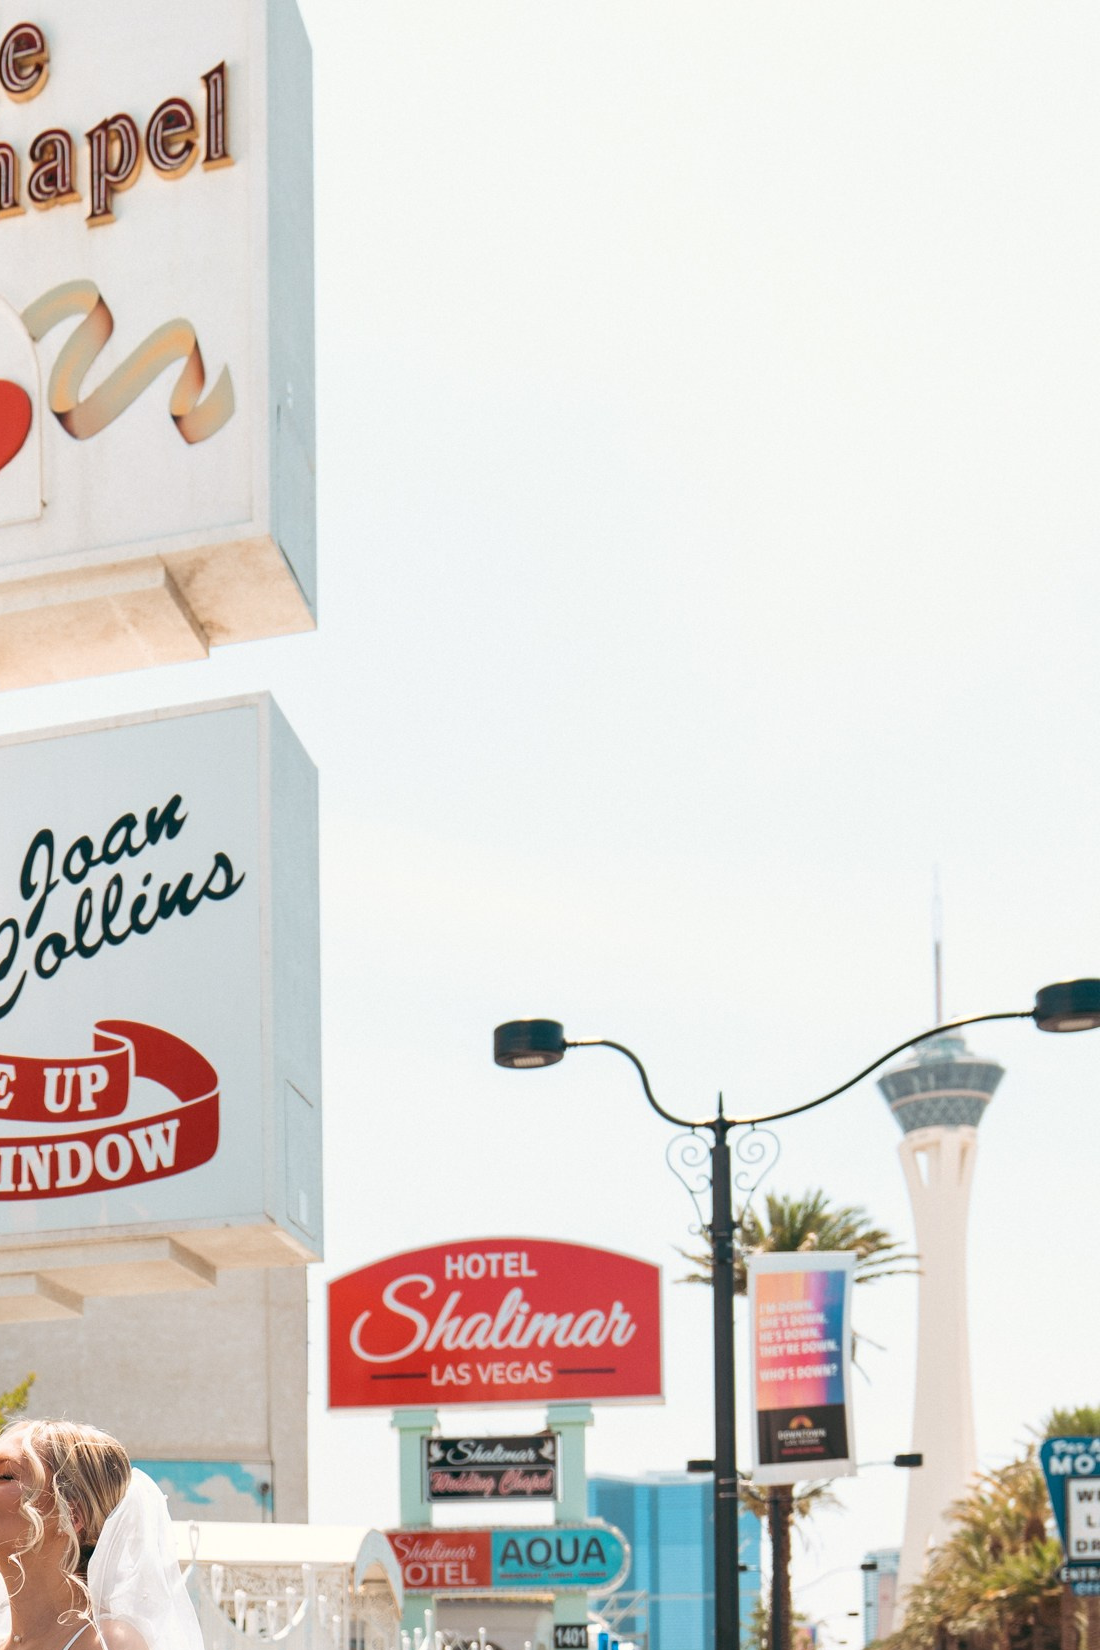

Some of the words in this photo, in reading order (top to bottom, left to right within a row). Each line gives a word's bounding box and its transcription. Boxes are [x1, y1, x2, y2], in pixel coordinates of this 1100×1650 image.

[19, 794, 188, 939] Joan
[43, 1066, 109, 1113] UP
[445, 1253, 537, 1280] HOTEL
[349, 1274, 637, 1363] Shalimar
[431, 1363, 472, 1386] LAS
[477, 1362, 553, 1384] VEGAS
[796, 1363, 838, 1379] DOWN?
[446, 1440, 538, 1465] Shalimar
[1050, 1453, 1100, 1475] MO
[431, 1470, 496, 1498] Wedding
[499, 1467, 553, 1496] Chapel
[394, 1535, 477, 1562] Shalimar
[500, 1537, 606, 1569] AQUA
[405, 1562, 477, 1586] OTEL
[555, 1627, 587, 1646] 1401
